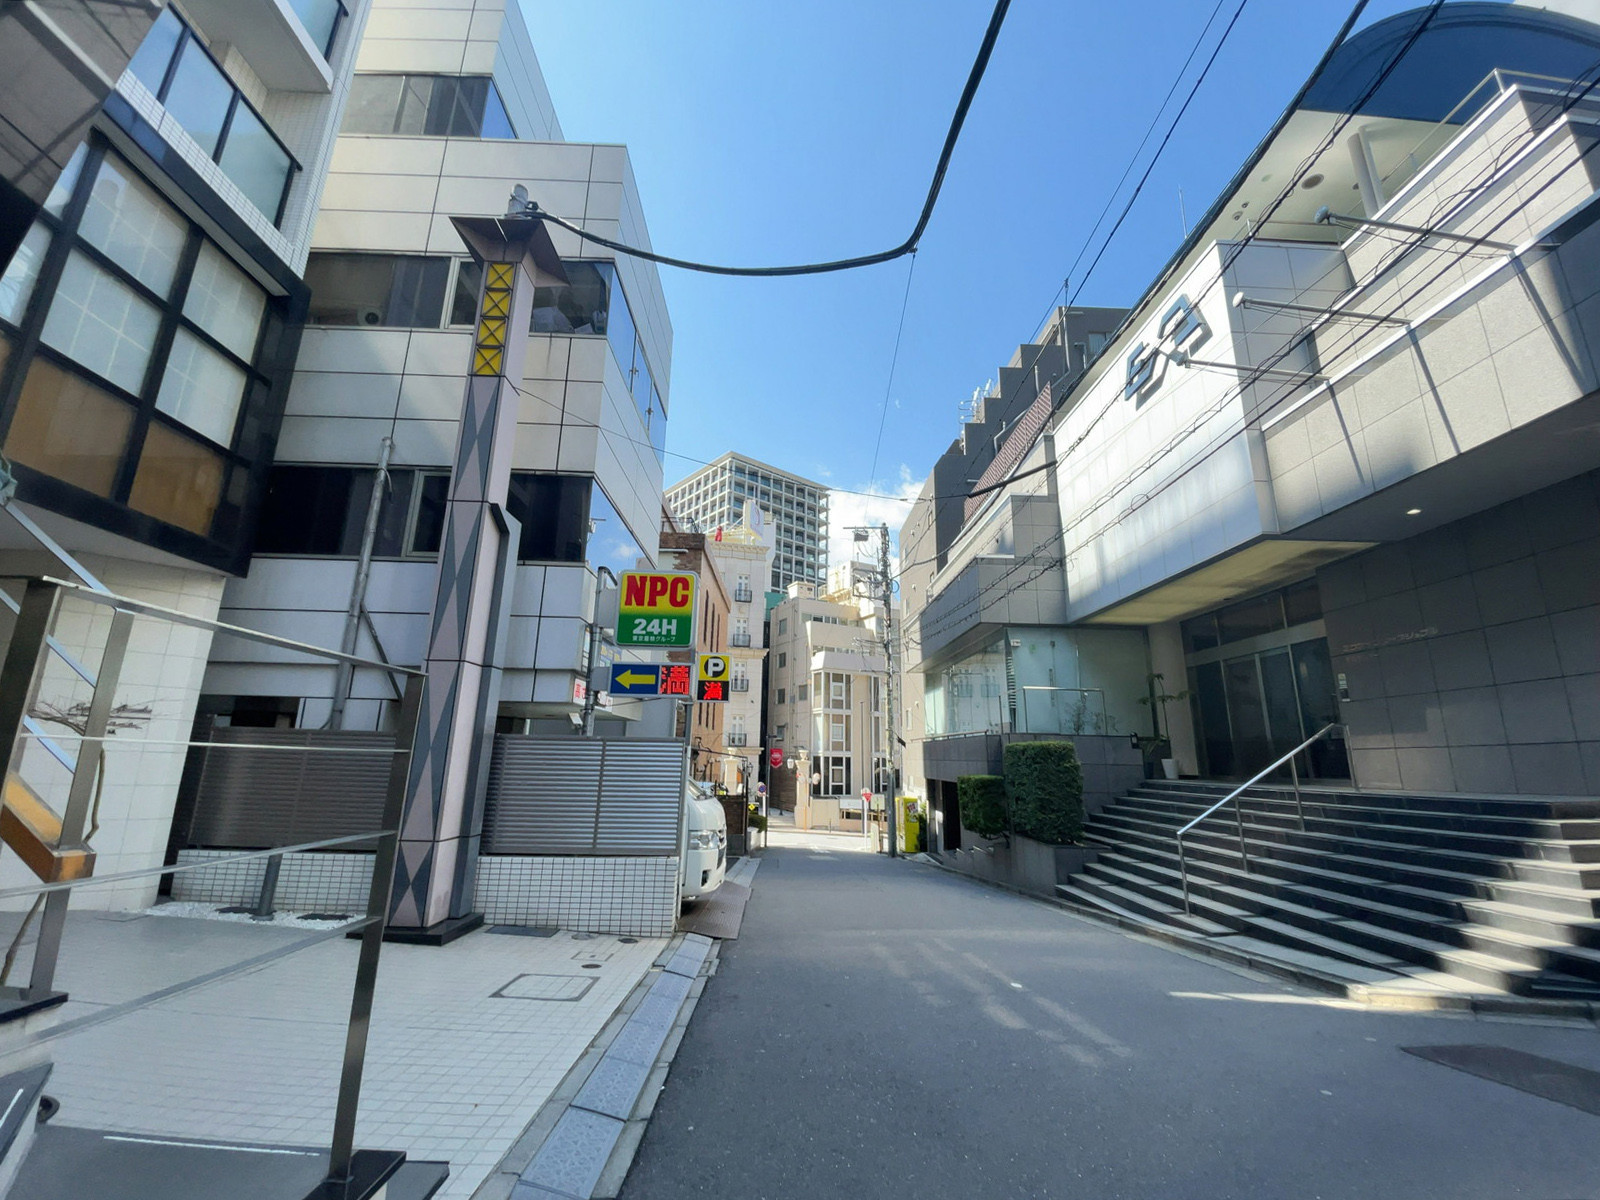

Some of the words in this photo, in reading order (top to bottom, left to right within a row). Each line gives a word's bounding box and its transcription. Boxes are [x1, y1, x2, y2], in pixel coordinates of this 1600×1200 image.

[625, 575, 689, 607] NPC
[632, 618, 677, 635] 24H
[708, 658, 725, 677] P
[660, 665, 691, 695] 満
